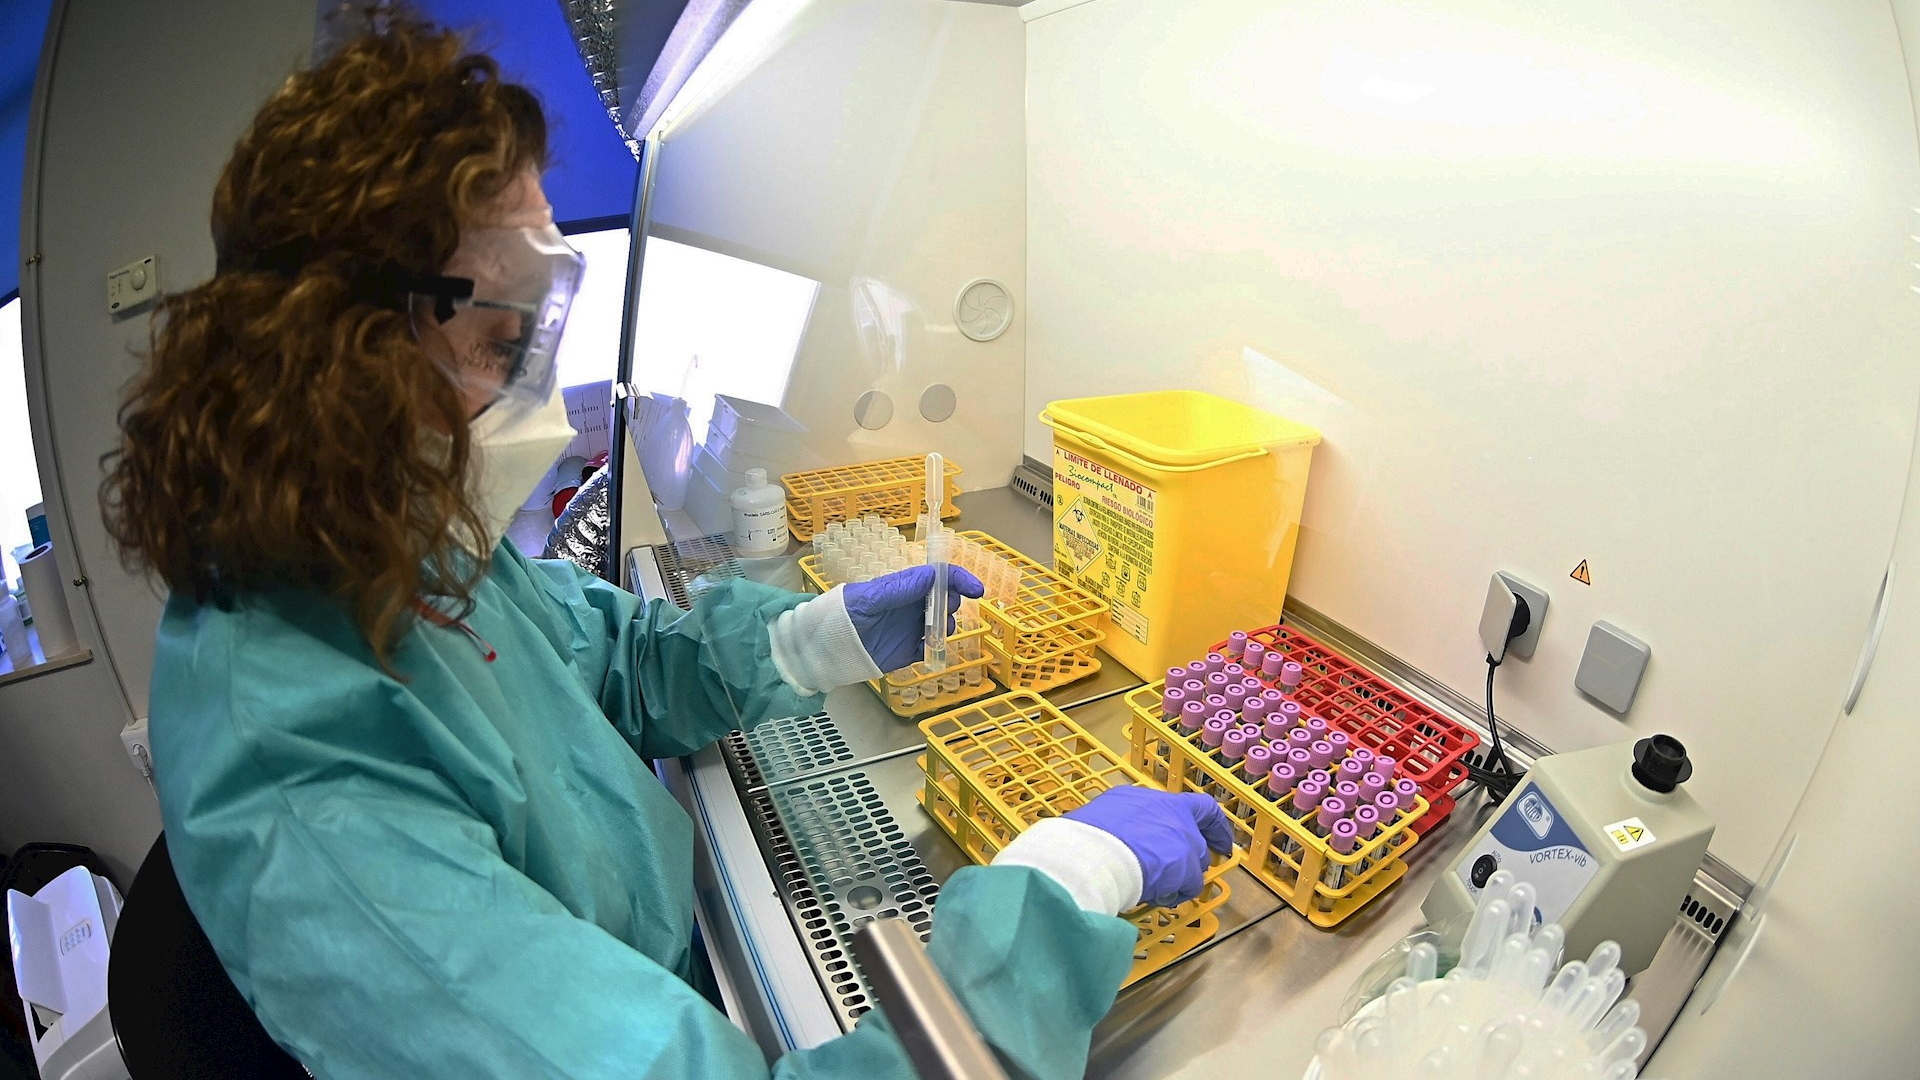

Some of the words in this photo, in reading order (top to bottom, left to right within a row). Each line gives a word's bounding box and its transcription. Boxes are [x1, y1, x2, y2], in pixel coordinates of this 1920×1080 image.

[1055, 472, 1080, 490] PELIGRO
[1064, 452, 1088, 469] LIMITE
[1091, 464, 1102, 475] DE
[1104, 469, 1142, 494] LLENADO
[1068, 464, 1113, 492] Biocompact
[1102, 496, 1121, 512] RIESGO
[1123, 506, 1153, 528] BIOLÓGICO
[1492, 850, 1502, 863] AUTO
[1529, 849, 1587, 867] VORTEX-vib
